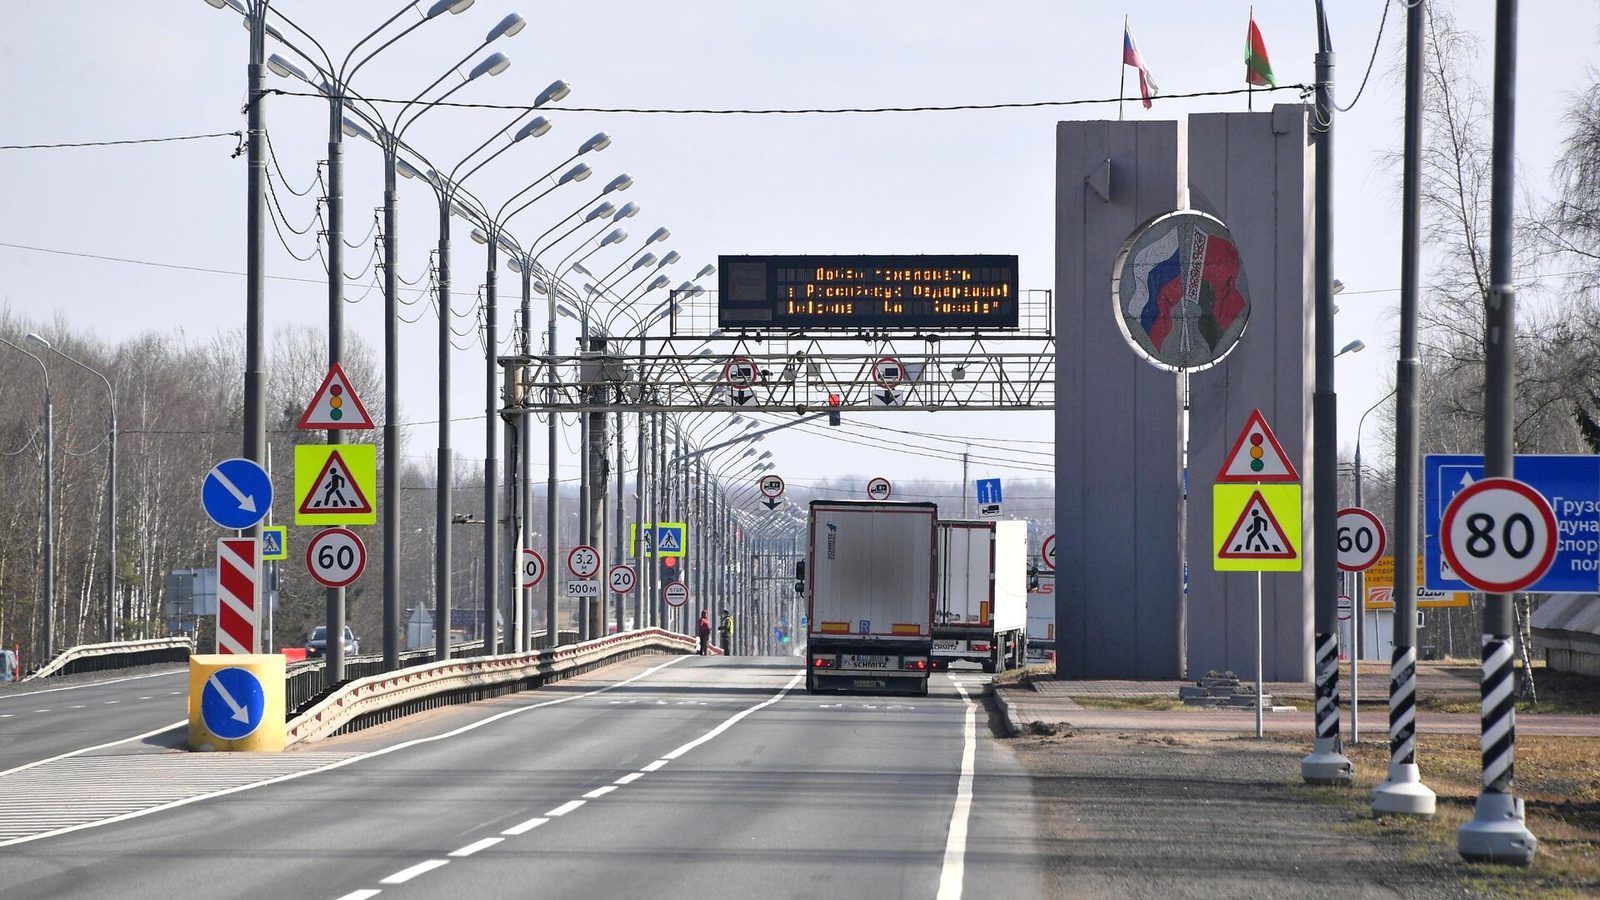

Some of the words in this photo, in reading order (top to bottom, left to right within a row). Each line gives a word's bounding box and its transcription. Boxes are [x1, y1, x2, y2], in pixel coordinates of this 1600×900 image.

[1337, 526, 1373, 553] 60
[1466, 513, 1534, 559] 80
[1557, 539, 1600, 555] спор
[318, 544, 354, 570] 60
[576, 553, 593, 566] 3,2
[522, 561, 537, 576] 0
[613, 573, 631, 586] 20
